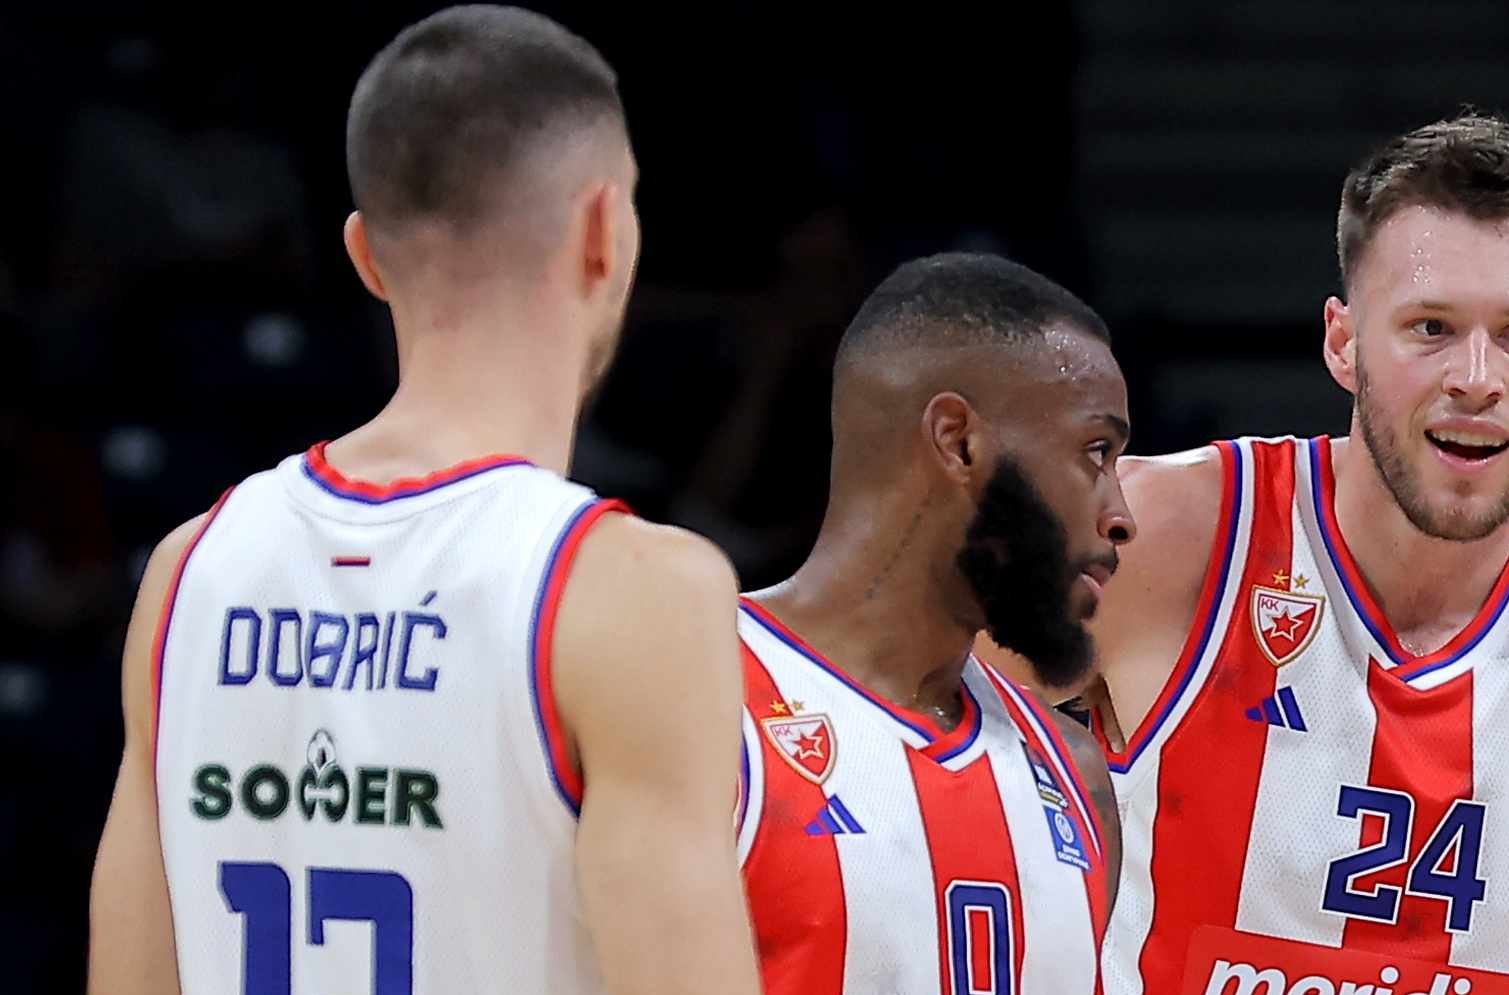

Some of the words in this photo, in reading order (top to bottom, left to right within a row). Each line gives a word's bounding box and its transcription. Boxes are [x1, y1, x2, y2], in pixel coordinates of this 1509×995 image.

[1260, 597, 1280, 612] KK
[217, 589, 448, 692] DOBRIĆ
[773, 726, 794, 737] KK
[1319, 784, 1488, 934] 24
